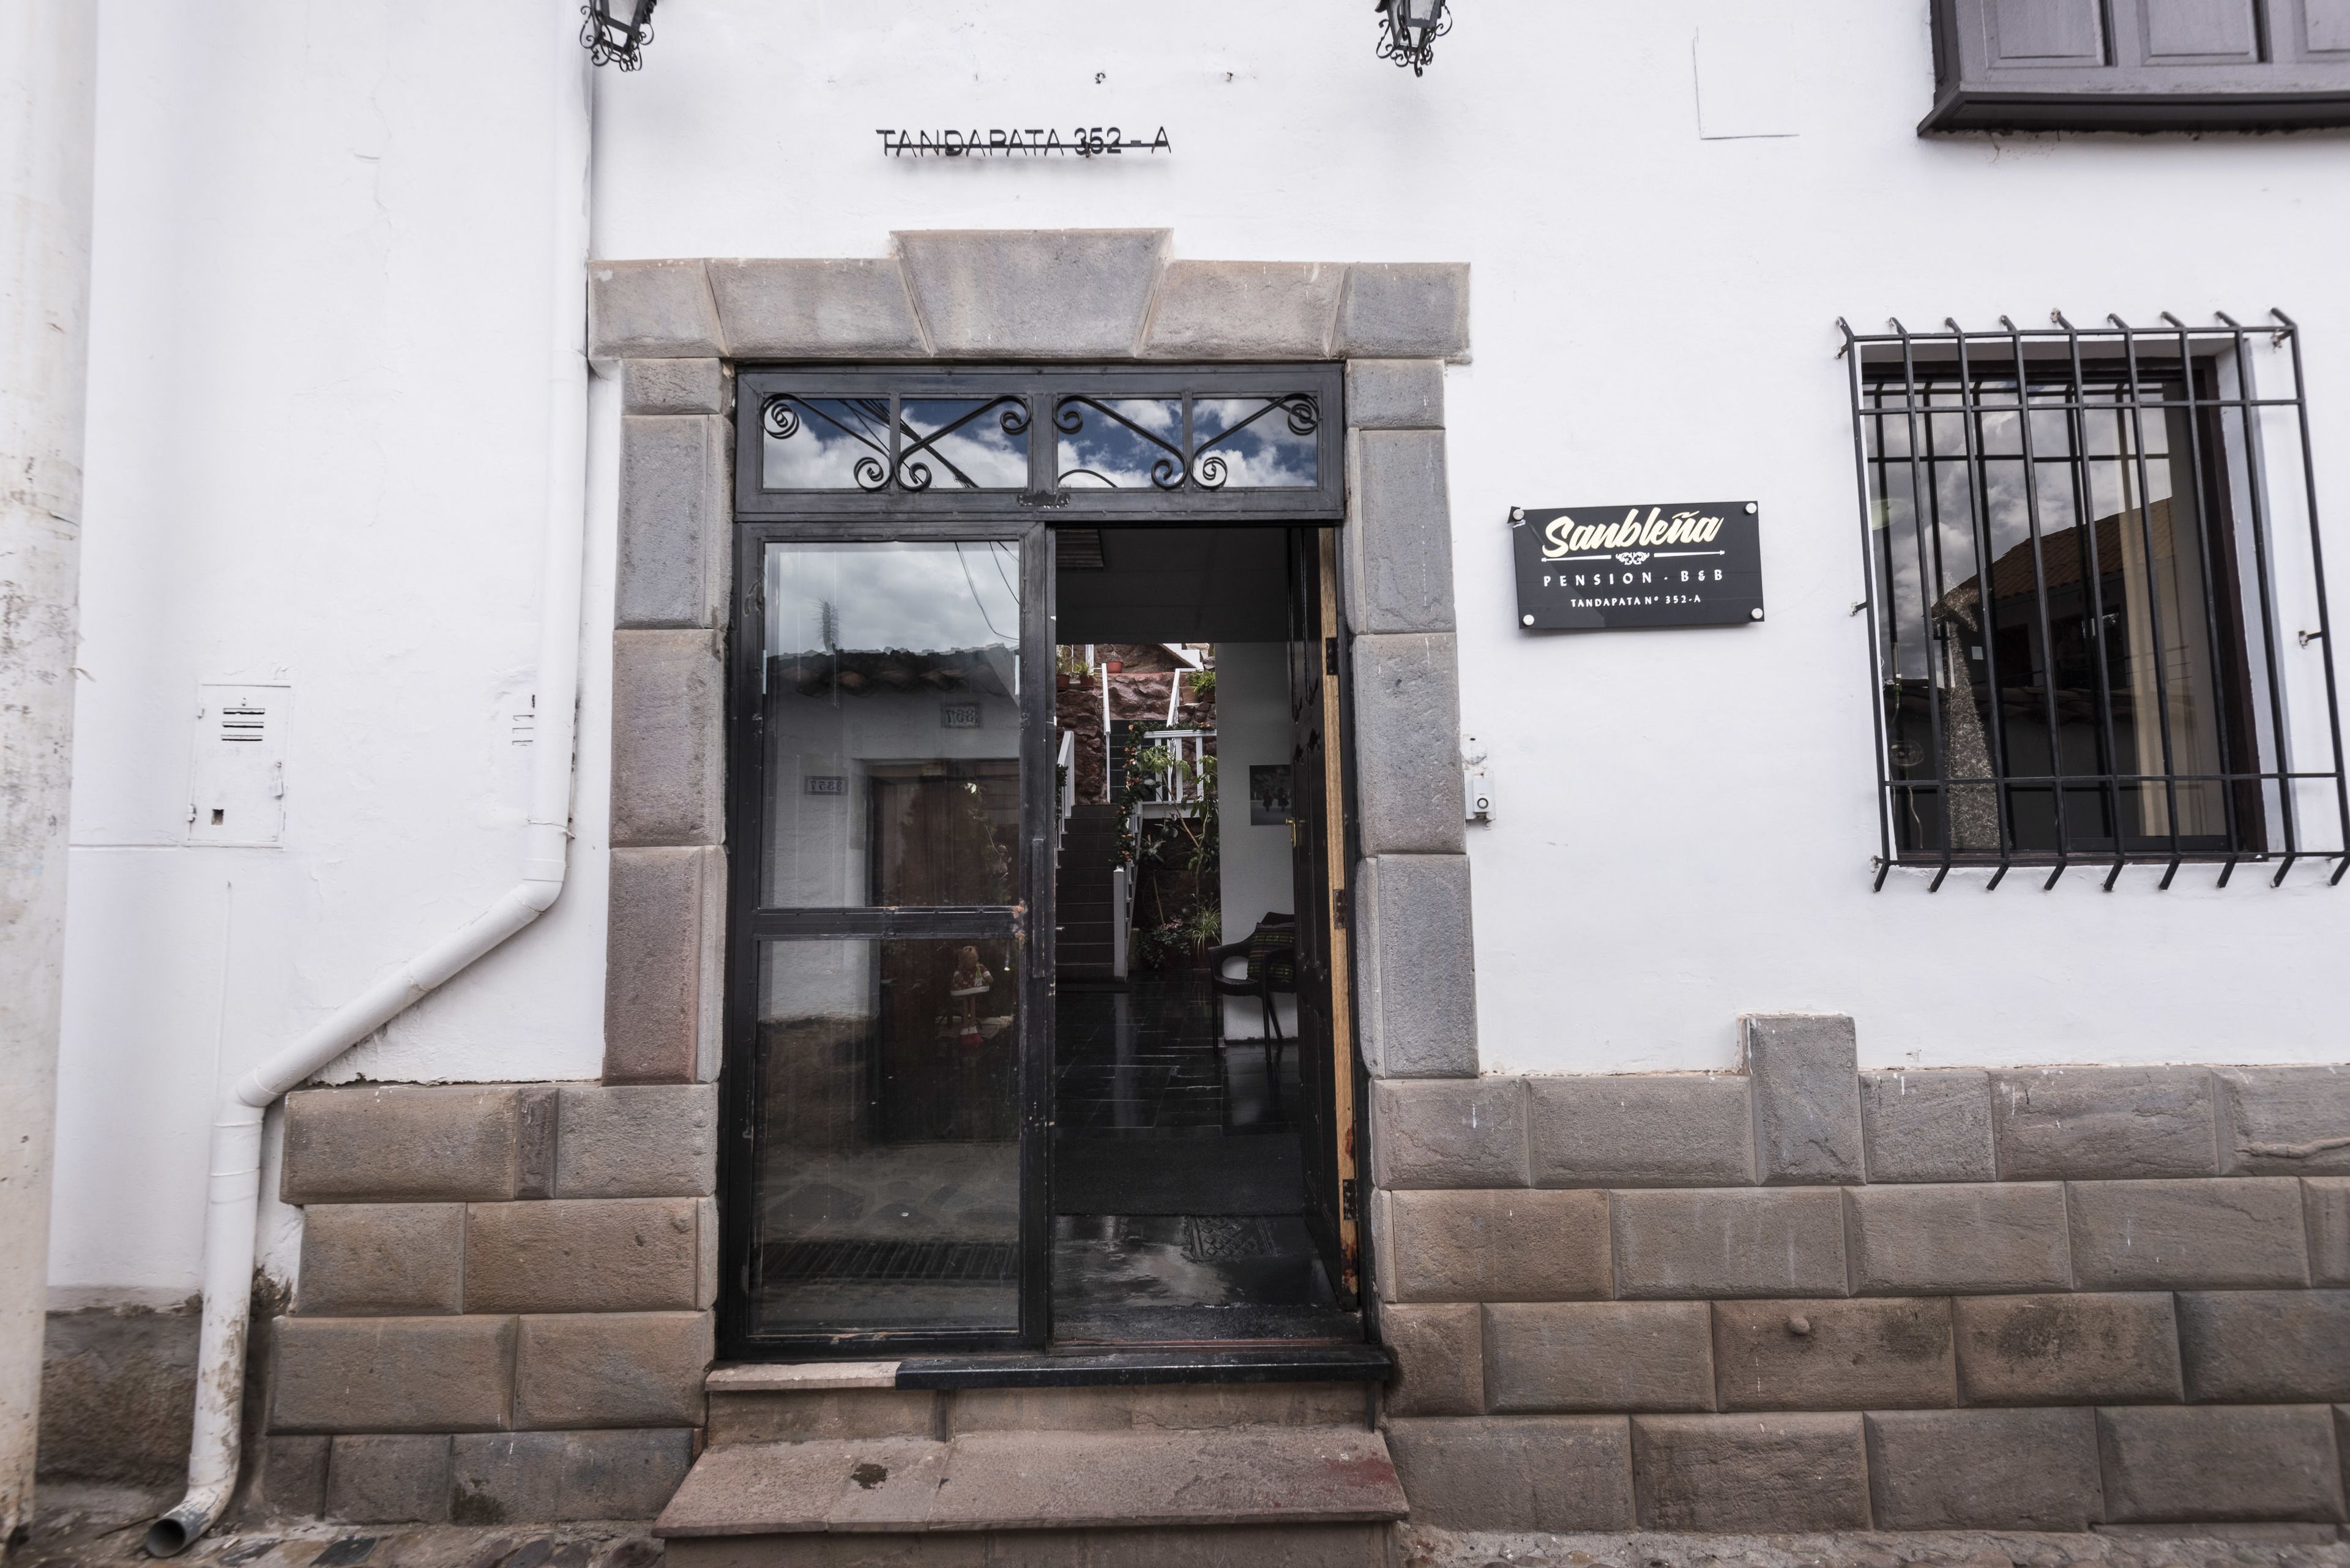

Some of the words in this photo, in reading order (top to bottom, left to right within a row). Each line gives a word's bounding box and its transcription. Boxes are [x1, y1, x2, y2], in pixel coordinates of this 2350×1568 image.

[876, 128, 1064, 157] TANDAPATA
[1074, 127, 1121, 155] 352
[1542, 507, 1725, 558] Sanbleña
[1543, 572, 1652, 587] PENSION
[1680, 569, 1723, 582] B&B
[1570, 597, 1641, 608] TANDAPATA
[1665, 594, 1701, 604] 352-A
